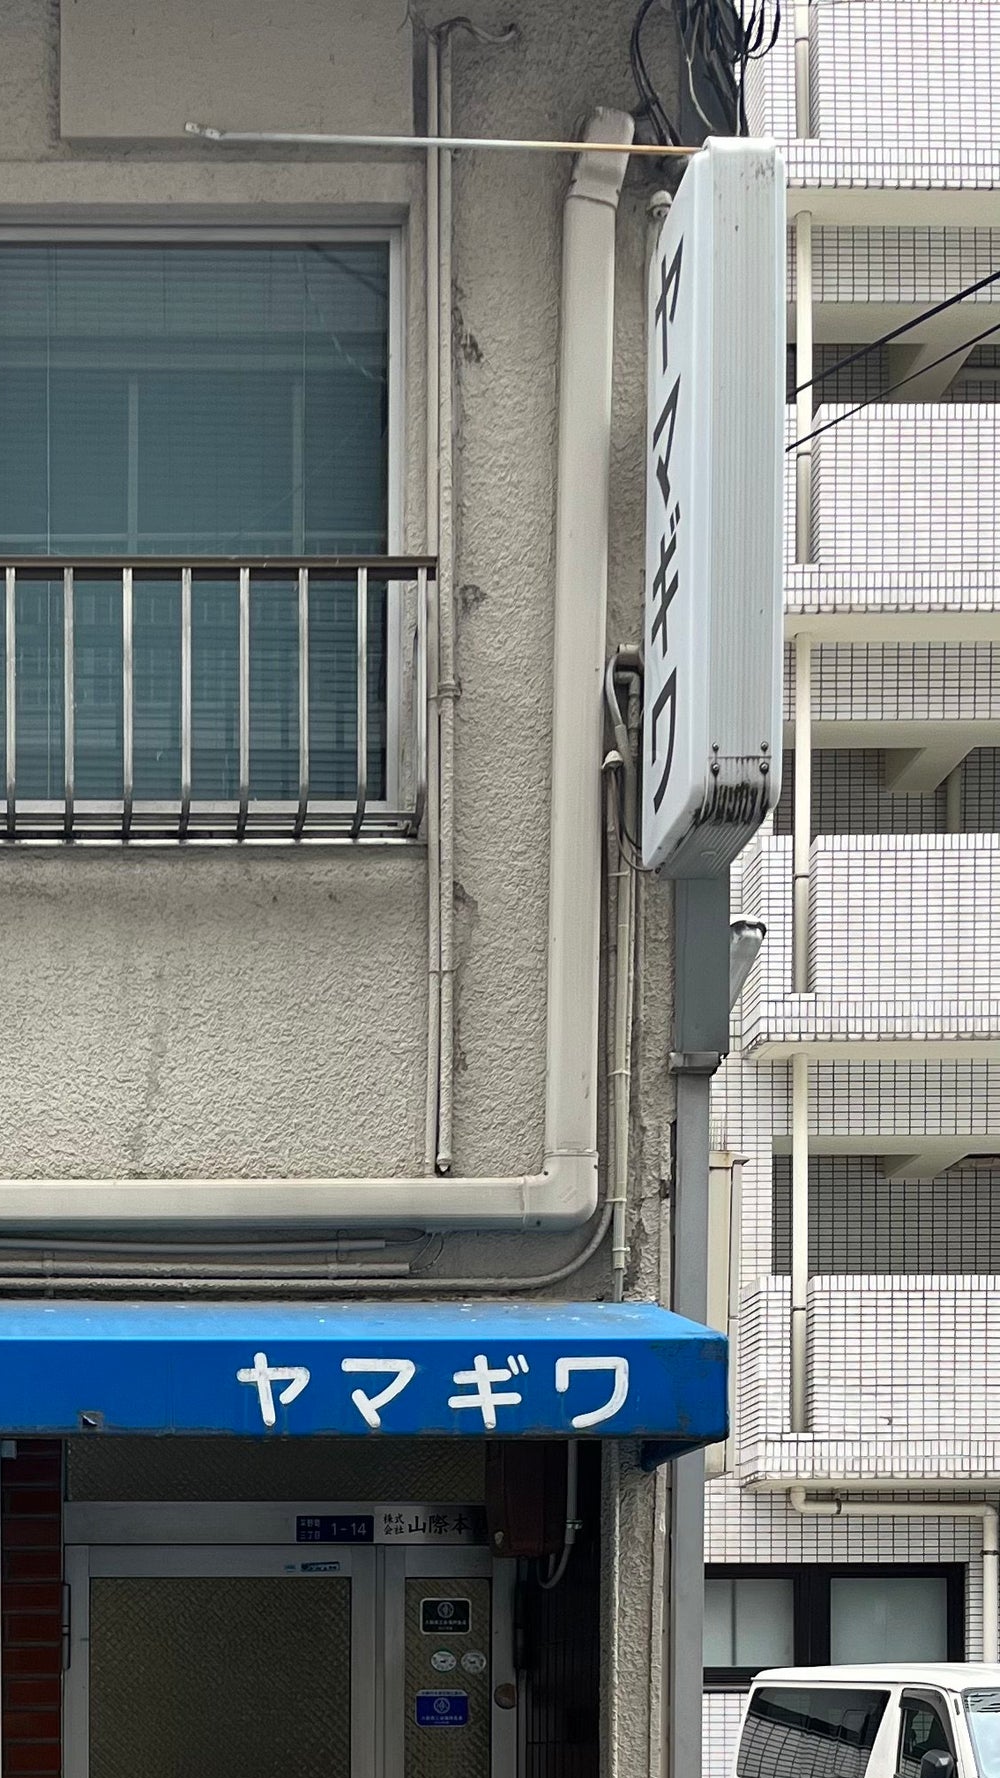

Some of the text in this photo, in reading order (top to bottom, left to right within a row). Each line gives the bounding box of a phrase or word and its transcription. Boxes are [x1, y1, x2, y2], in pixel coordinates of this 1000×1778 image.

[652, 233, 684, 816] ヤマギワ
[236, 1352, 629, 1429] ヤマギワ
[331, 1522, 367, 1537] 1-14
